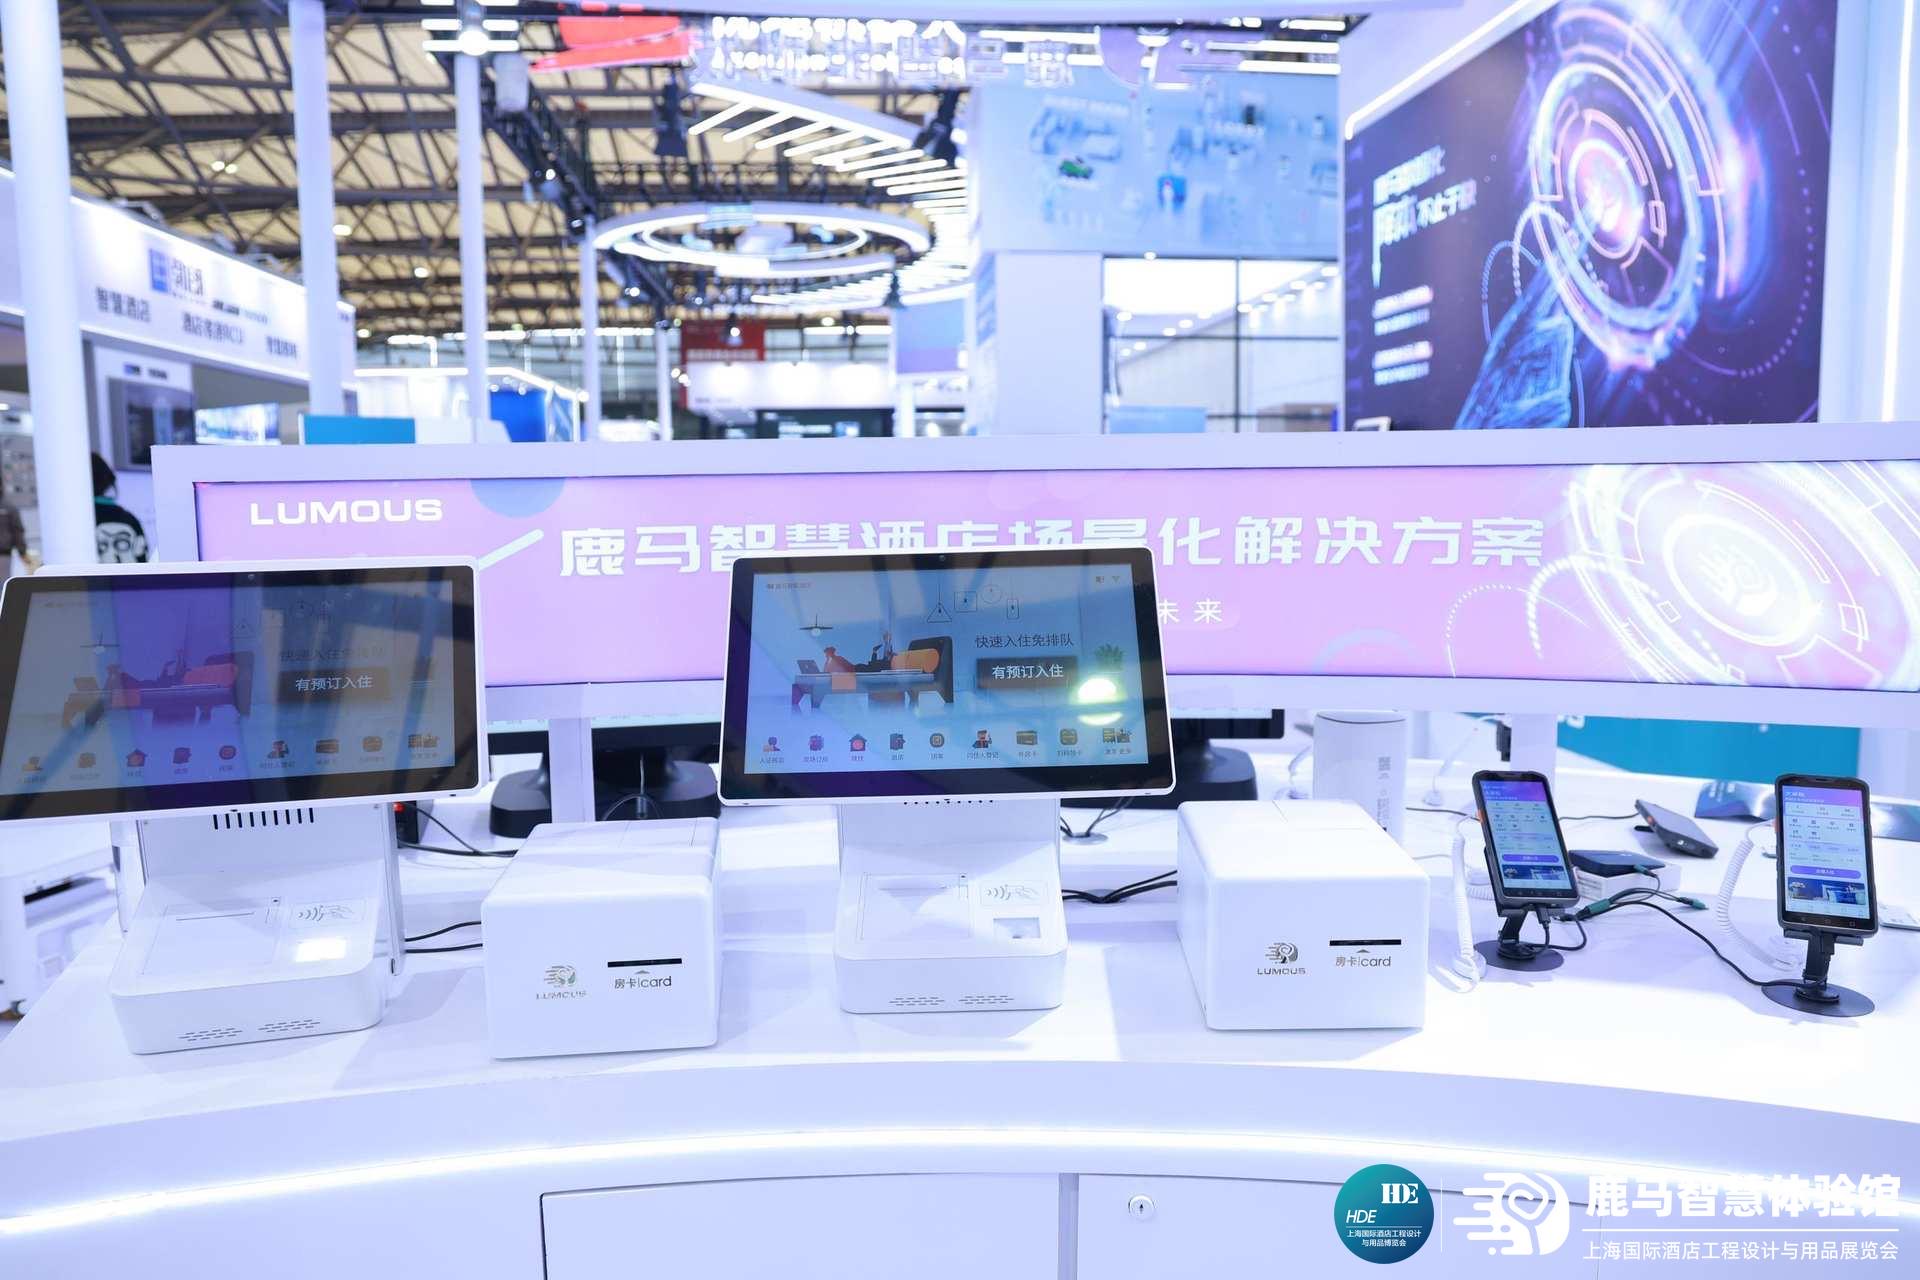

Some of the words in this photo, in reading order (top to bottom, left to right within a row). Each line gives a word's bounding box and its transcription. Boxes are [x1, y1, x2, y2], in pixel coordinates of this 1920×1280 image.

[250, 499, 443, 525] LUMOUS
[976, 632, 1074, 648] 快速入住免排队
[992, 664, 1064, 680] 有预订入住
[295, 675, 373, 692] 有预订入住
[1256, 967, 1306, 976] LUMOUS
